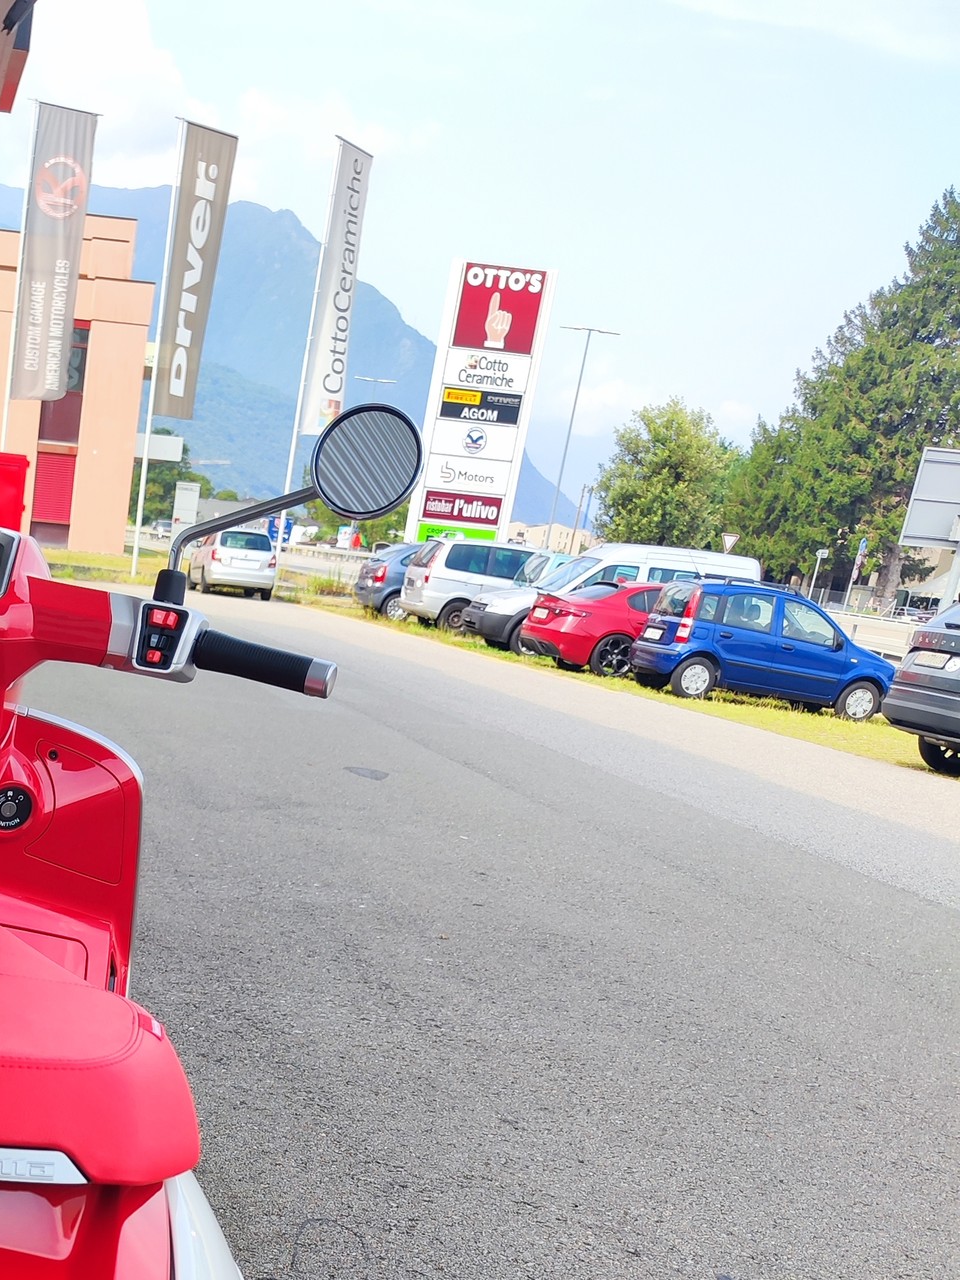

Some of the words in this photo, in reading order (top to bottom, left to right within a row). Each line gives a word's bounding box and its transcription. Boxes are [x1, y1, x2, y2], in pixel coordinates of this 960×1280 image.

[323, 158, 363, 394] CottoCeramiche
[467, 266, 542, 293] OTTO'S
[29, 281, 47, 323] GARAGE
[48, 259, 70, 337] MOTORCYCLES
[24, 326, 41, 371] CUSTOM
[45, 340, 63, 391] AMERICAN
[478, 356, 508, 372] Cotto
[458, 369, 514, 388] Ceramiche
[460, 407, 498, 421] AGOM
[457, 470, 494, 483] Motors
[453, 498, 498, 520] l'ulivo
